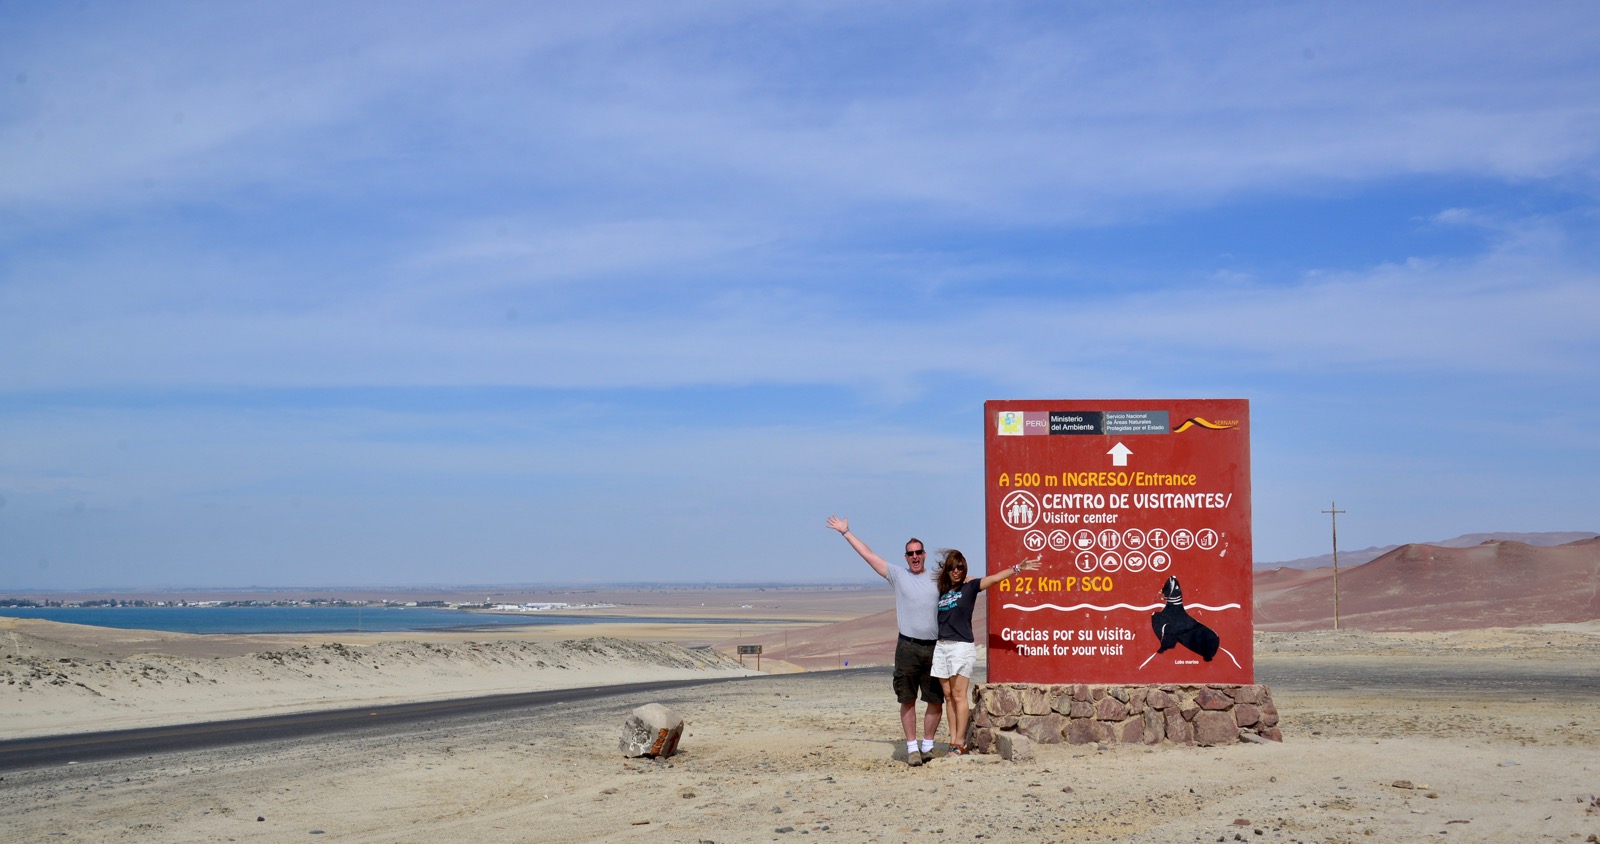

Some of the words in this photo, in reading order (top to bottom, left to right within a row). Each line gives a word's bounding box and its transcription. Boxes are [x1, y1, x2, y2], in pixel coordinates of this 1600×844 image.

[1025, 419, 1047, 427] PERÚ
[999, 472, 1010, 487] A
[1014, 472, 1041, 487] 500
[1045, 475, 1058, 487] m
[1062, 471, 1197, 487] INGRESO/Entrance
[1042, 493, 1105, 509] CENTRO
[1109, 493, 1130, 509] DE
[1133, 493, 1233, 509] VISITANTES/
[1042, 511, 1081, 524] Visitor
[1083, 513, 1118, 524] center
[1000, 577, 1011, 592] A
[1015, 577, 1033, 592] 27
[1038, 576, 1062, 592] Km
[1066, 576, 1114, 592] PSCO
[1001, 627, 1049, 641] Gracias
[1053, 628, 1075, 641] por
[1078, 629, 1093, 641] su
[1096, 626, 1136, 641] visita,
[1016, 644, 1050, 656] Thank
[1053, 644, 1070, 656] for
[1071, 645, 1097, 656] your
[1100, 643, 1124, 656] visit
